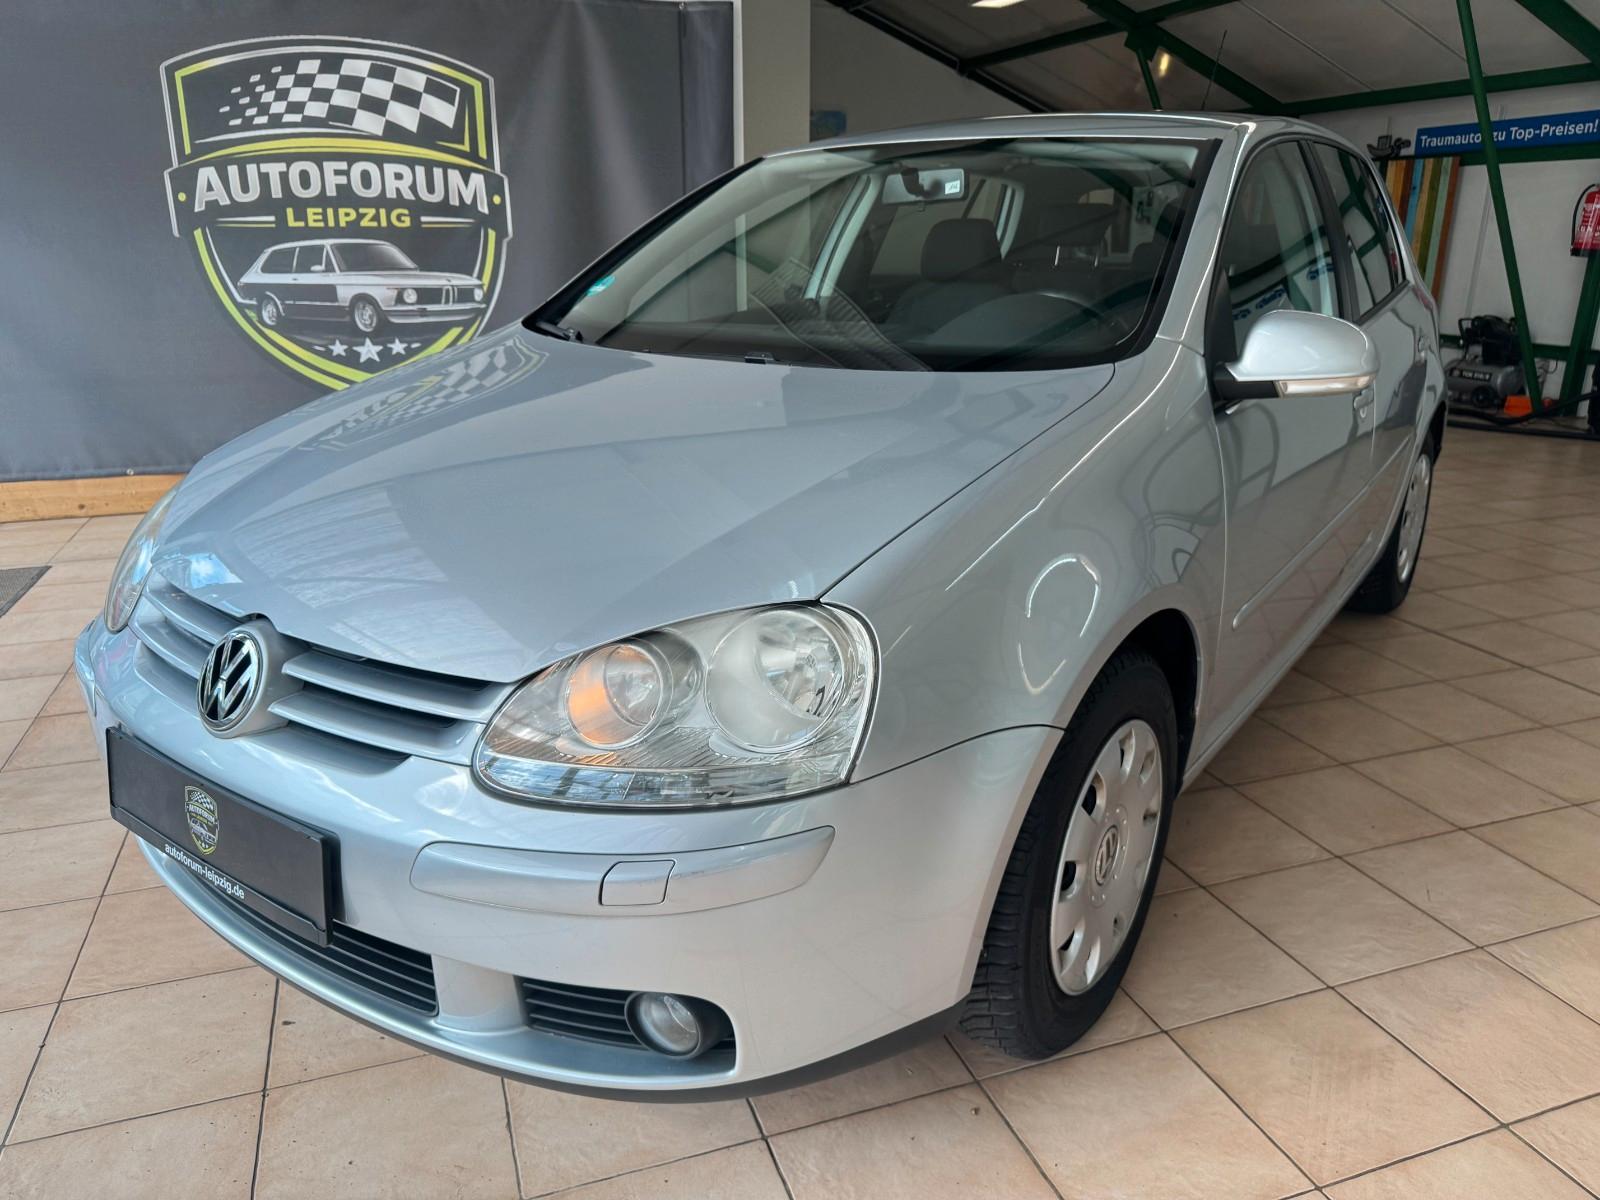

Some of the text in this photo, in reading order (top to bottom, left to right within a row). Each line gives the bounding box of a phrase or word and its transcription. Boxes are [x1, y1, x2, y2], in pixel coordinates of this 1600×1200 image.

[1420, 118, 1599, 148] Traumauto zu Top-Preisen!
[193, 160, 490, 215] AUTOFORUM
[285, 207, 412, 228] LEIPZIG
[164, 843, 246, 900] autoforum-leipzig.de
